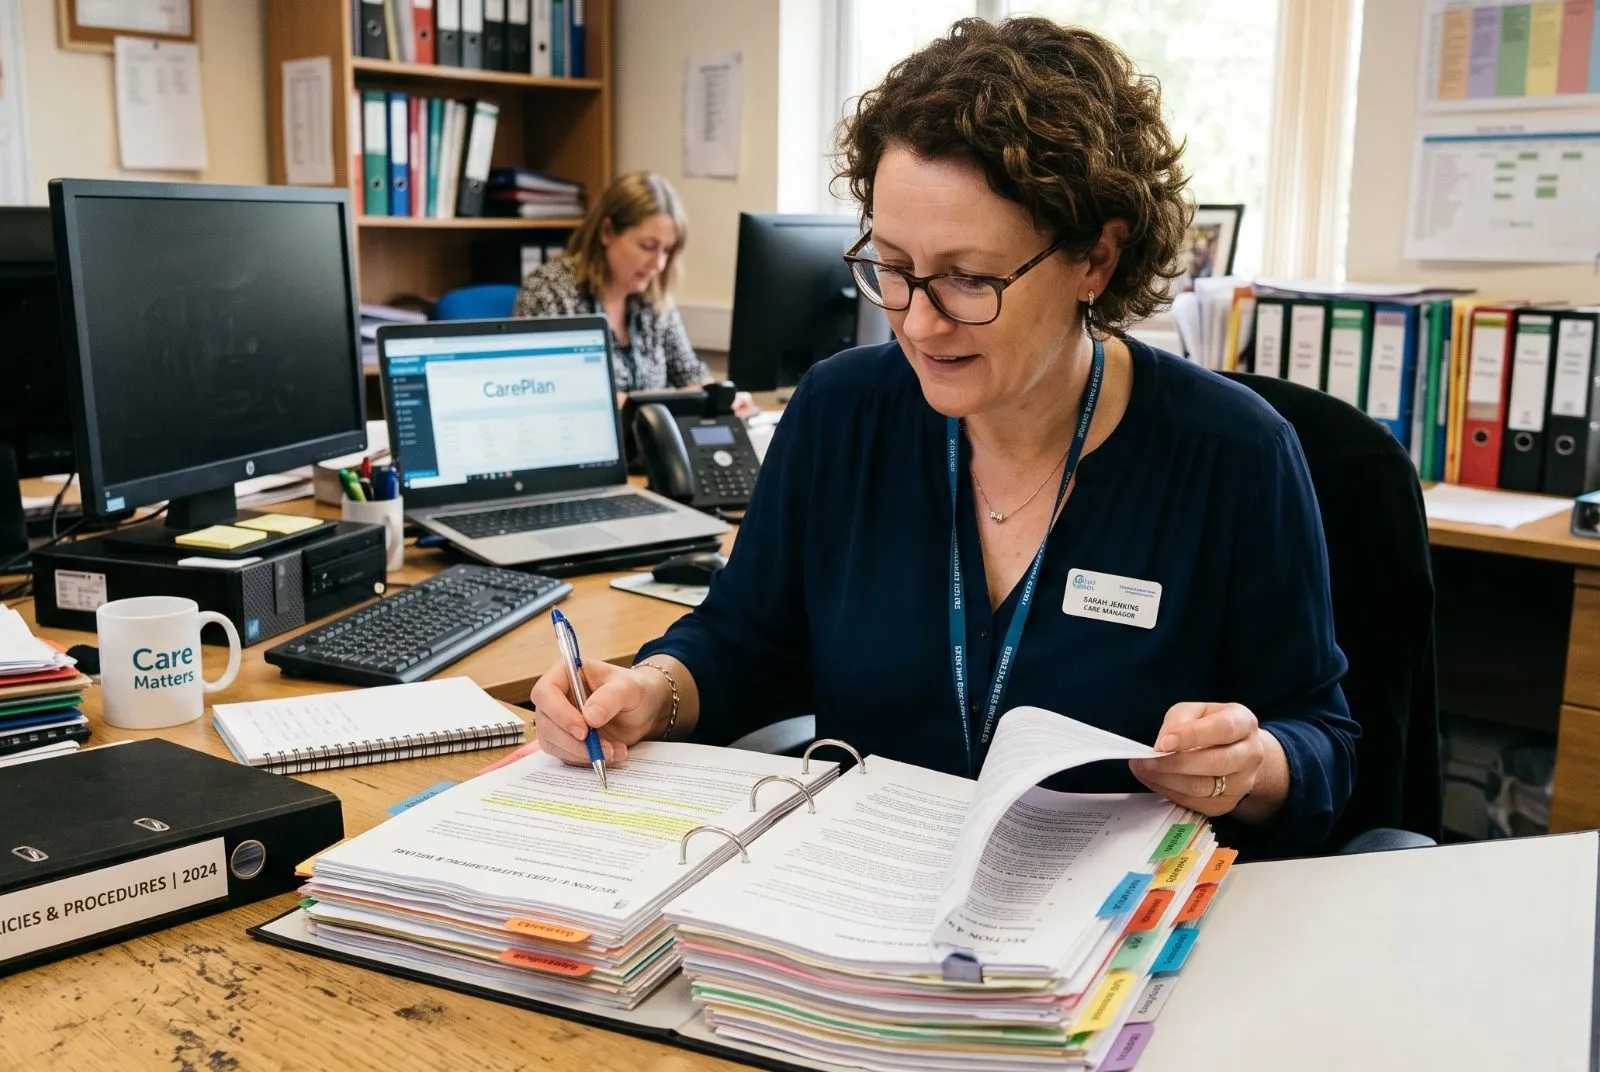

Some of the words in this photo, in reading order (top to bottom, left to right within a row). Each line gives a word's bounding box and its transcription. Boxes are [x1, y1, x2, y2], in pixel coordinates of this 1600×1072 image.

[483, 379, 556, 398] CarePlan
[1083, 596, 1108, 606] SARAH
[1108, 602, 1140, 612] JENKINS
[1083, 604, 1100, 613] CARE
[132, 647, 193, 671] Care
[134, 671, 194, 689] Matters
[0, 910, 41, 936] ICIES
[46, 905, 60, 922] &
[64, 876, 167, 917] PROCEDURES
[182, 862, 218, 884] 2024
